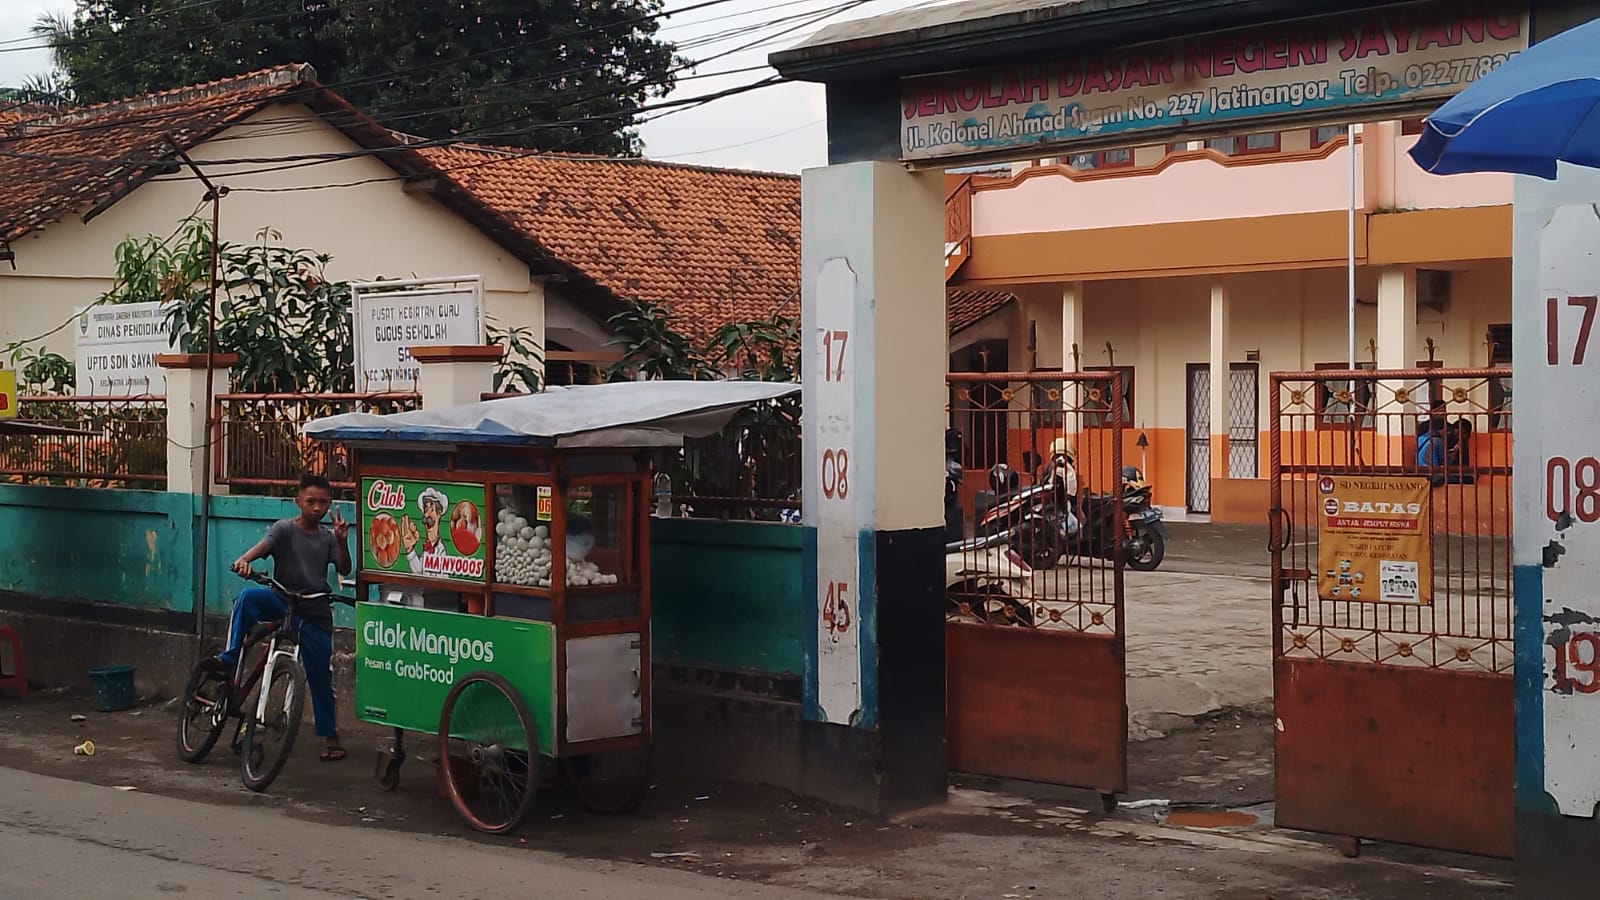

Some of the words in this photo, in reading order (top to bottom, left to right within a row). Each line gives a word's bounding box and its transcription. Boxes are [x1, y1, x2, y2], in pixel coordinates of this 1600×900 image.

[904, 62, 1049, 120] SEKOLAH
[1058, 47, 1174, 98] DASAR
[1184, 30, 1328, 80] NEGERI
[1338, 8, 1521, 62] SAYANG
[928, 116, 994, 145] Kolonel
[999, 107, 1066, 137] Ahmad
[1128, 95, 1163, 122] No.
[1168, 91, 1204, 117] 227
[1210, 79, 1329, 114] Jatinangor
[1340, 67, 1399, 98] Telp.
[98, 325, 121, 338] DINAS
[372, 307, 395, 320] PUSAT
[399, 305, 435, 319] KEGIATAN
[438, 304, 460, 318] GURU
[375, 325, 403, 342] GUGUS
[405, 323, 447, 340] SEKOLAH
[1546, 296, 1599, 366] 17
[87, 355, 108, 371] UPTD
[110, 354, 128, 369] SDN
[131, 352, 160, 369] SAYAN
[822, 330, 849, 382] 17
[368, 480, 405, 510] Cilok
[821, 448, 849, 500] 08
[1340, 480, 1352, 489] SD
[1546, 456, 1600, 523] 08
[1343, 501, 1421, 515] BATAS
[822, 580, 850, 635] 45
[363, 620, 407, 650] Cilok
[409, 626, 494, 664] Manyoos
[1553, 632, 1600, 694] 19
[364, 656, 385, 670] Pesan
[385, 659, 392, 671] di
[395, 659, 454, 685] GrabFood
